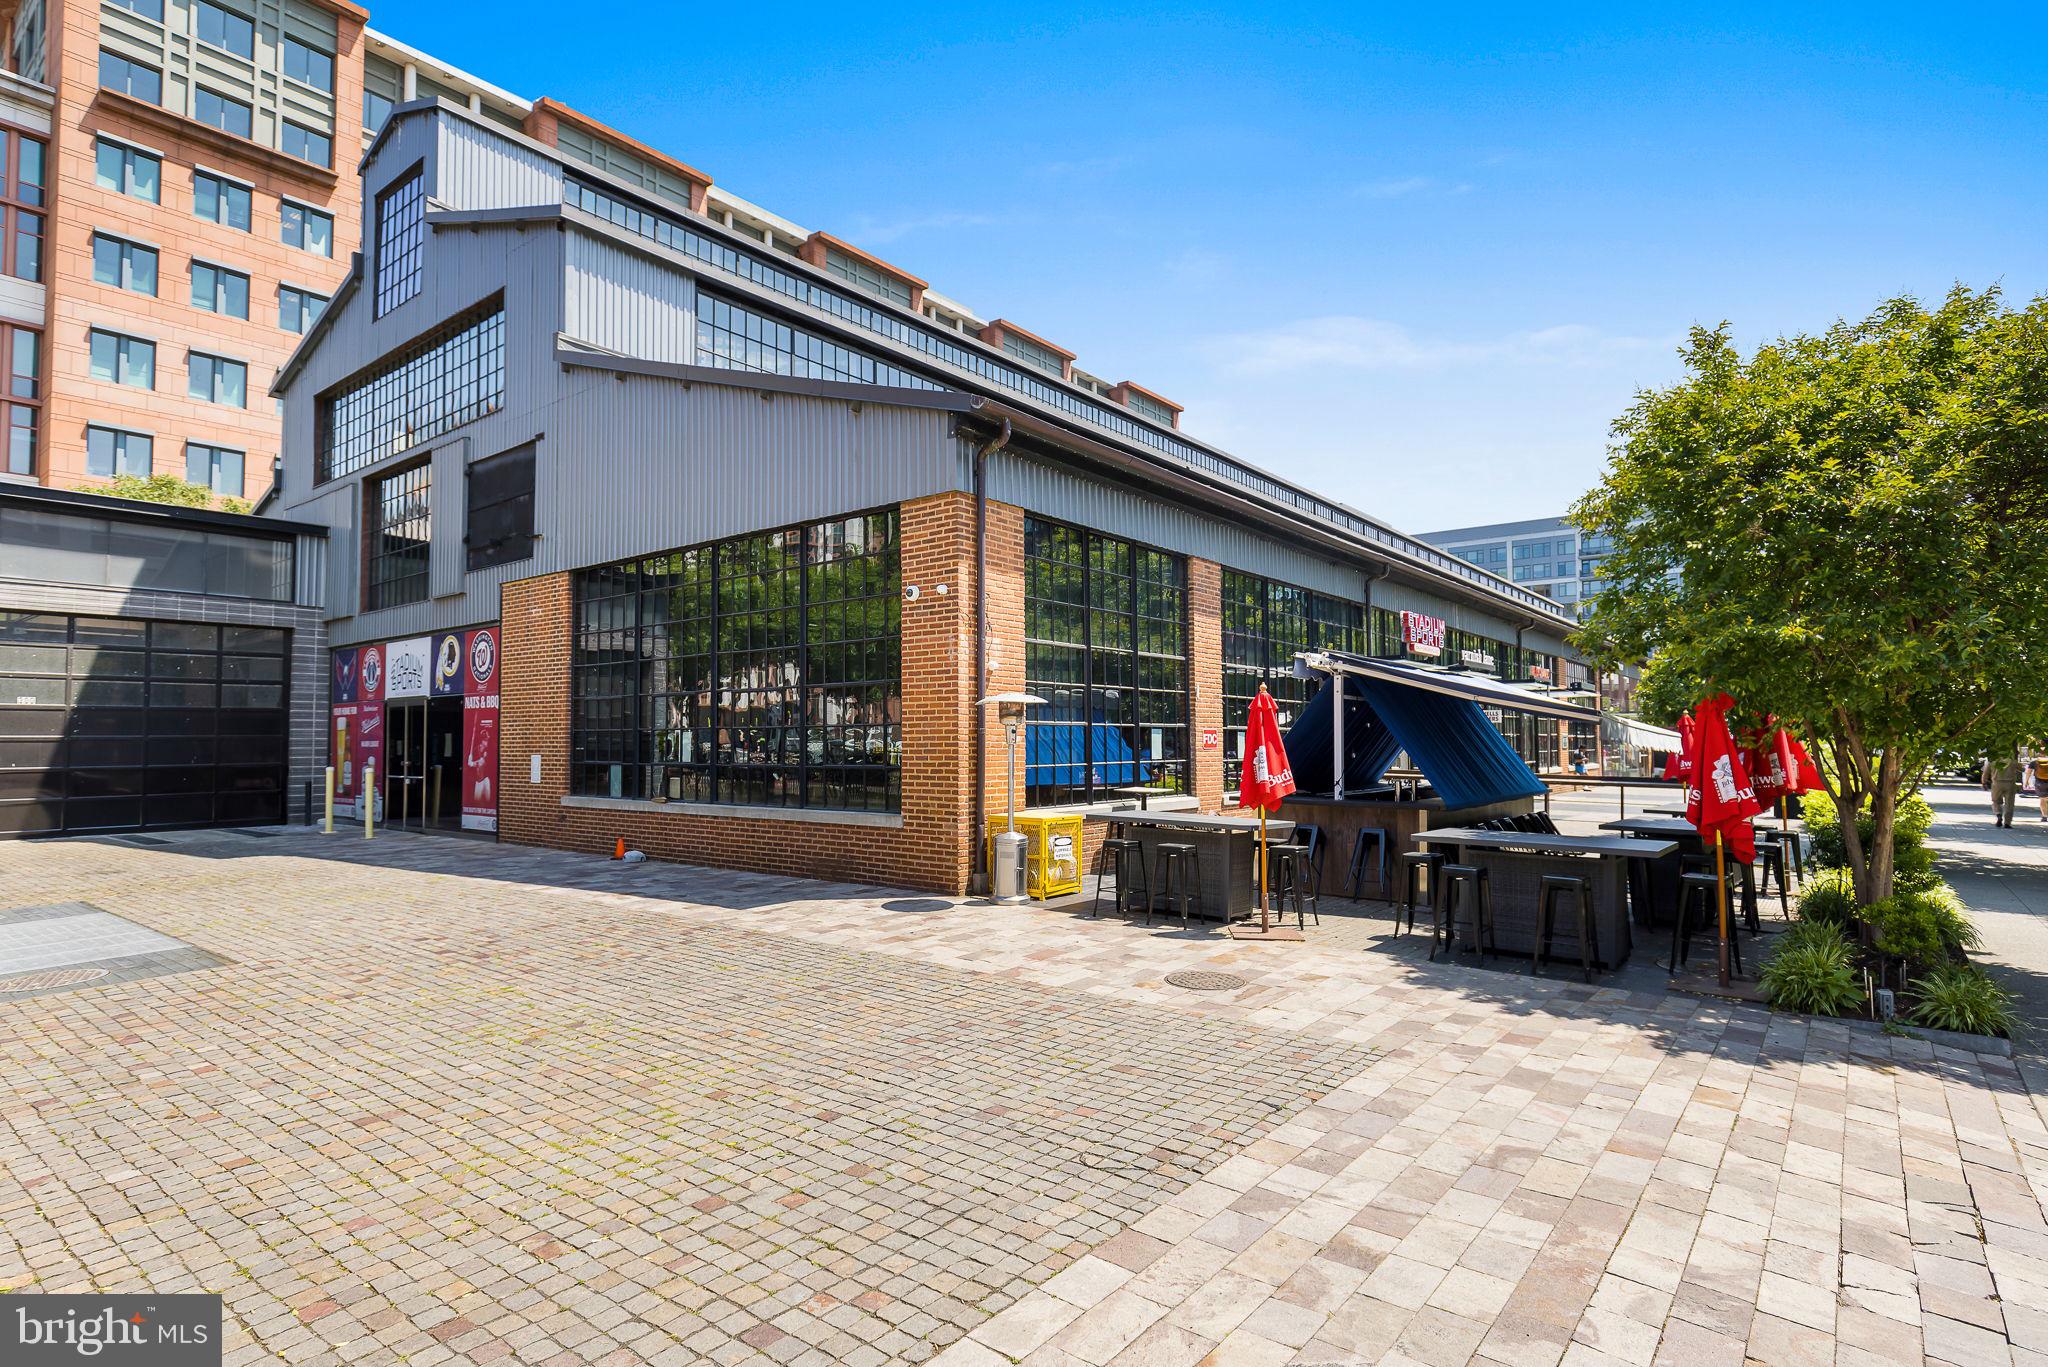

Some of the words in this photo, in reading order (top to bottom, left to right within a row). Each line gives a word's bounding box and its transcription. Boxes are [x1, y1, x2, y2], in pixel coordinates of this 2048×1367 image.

[1408, 611, 1445, 635] STADIUM
[1410, 626, 1444, 648] SPORTS
[391, 653, 424, 679] STADIUM
[391, 671, 422, 691] SPORTS
[465, 696, 480, 709] NATS
[480, 696, 486, 709] &
[486, 694, 499, 709] BBQ
[1203, 734, 1218, 745] FDC
